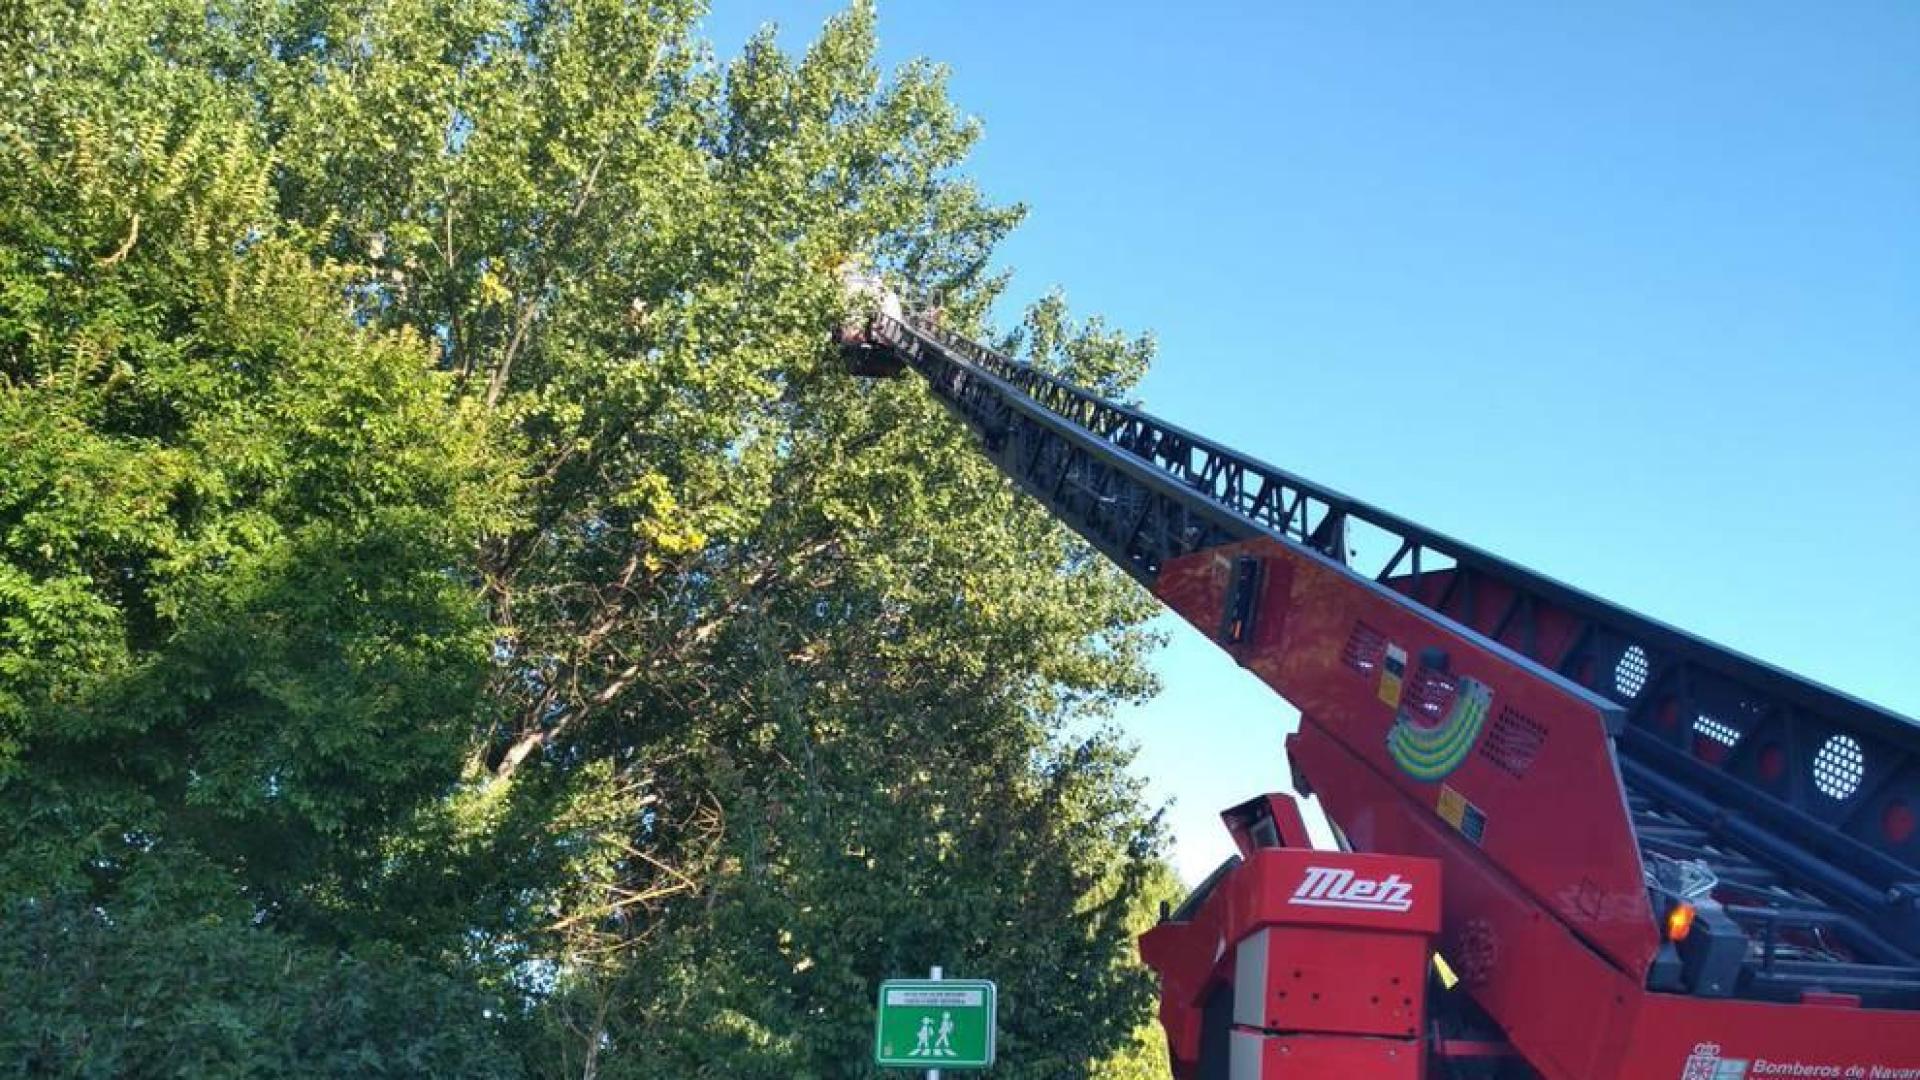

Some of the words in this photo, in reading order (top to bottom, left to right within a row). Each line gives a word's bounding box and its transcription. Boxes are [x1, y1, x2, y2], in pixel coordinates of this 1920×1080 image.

[1293, 866, 1413, 903] Metz
[1752, 1059, 1839, 1077] Bomberos
[1845, 1063, 1865, 1078] de
